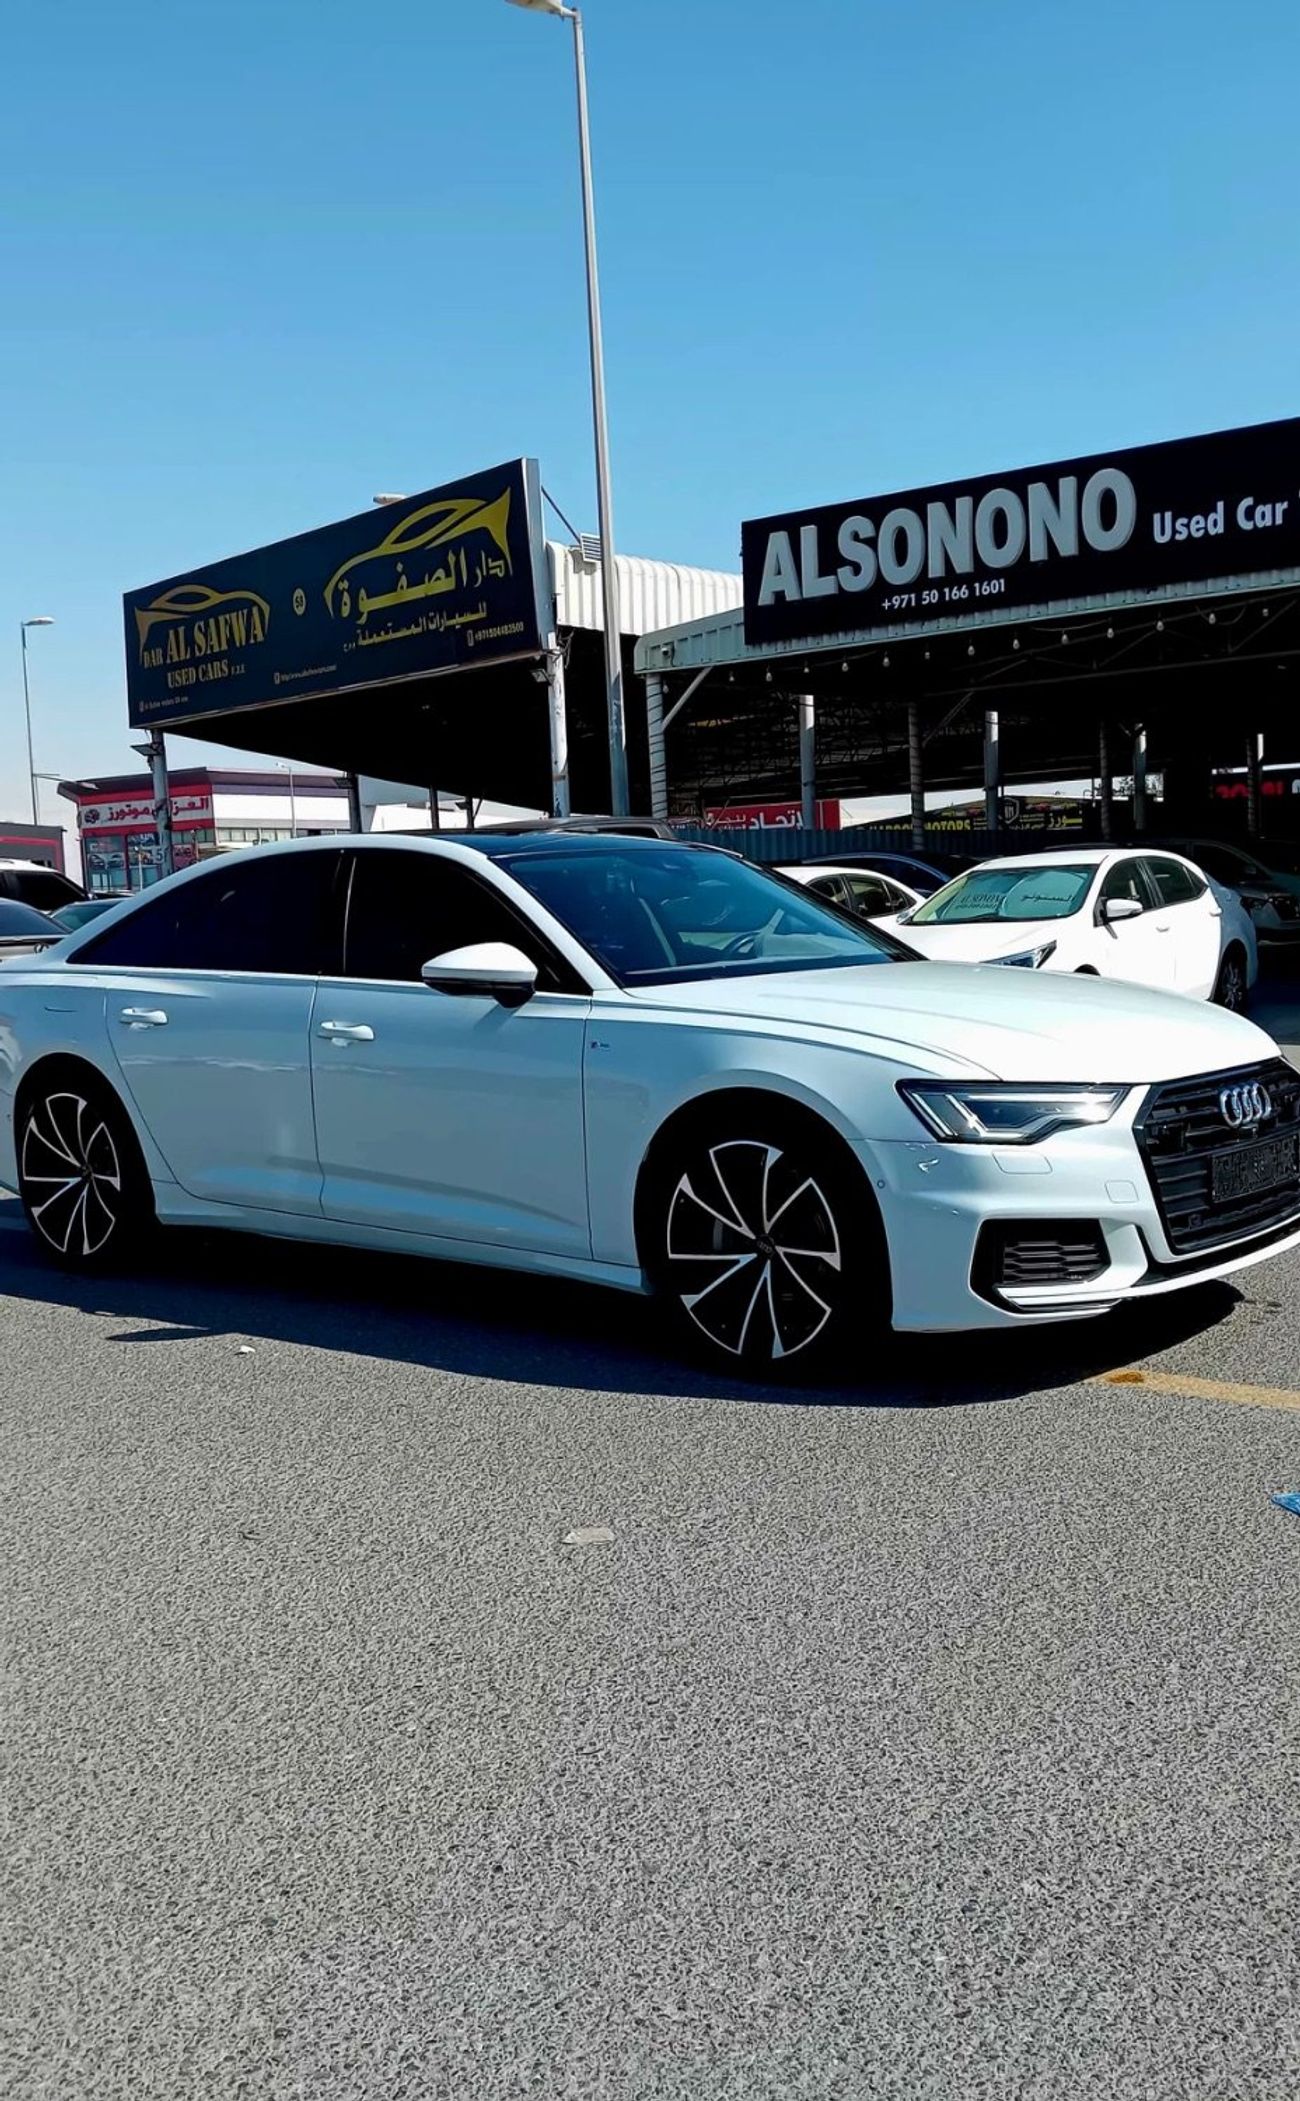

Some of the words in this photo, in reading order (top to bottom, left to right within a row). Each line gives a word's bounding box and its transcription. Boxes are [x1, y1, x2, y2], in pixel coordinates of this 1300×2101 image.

[758, 468, 1137, 606] ALSONONO
[1153, 500, 1224, 543] Used
[1236, 496, 1288, 530] Car
[337, 546, 468, 625] الصفوة
[474, 549, 506, 588] دار
[882, 593, 916, 610] +971
[922, 589, 939, 605] 50
[943, 584, 969, 601] 166
[974, 578, 1005, 597] 1601
[358, 616, 428, 646] المستعملة
[429, 601, 487, 631] للسيارات
[143, 648, 164, 669] DAR
[166, 626, 191, 664] AL
[193, 605, 264, 658] SAFWA
[167, 667, 197, 689] USED
[199, 660, 229, 682] CARS
